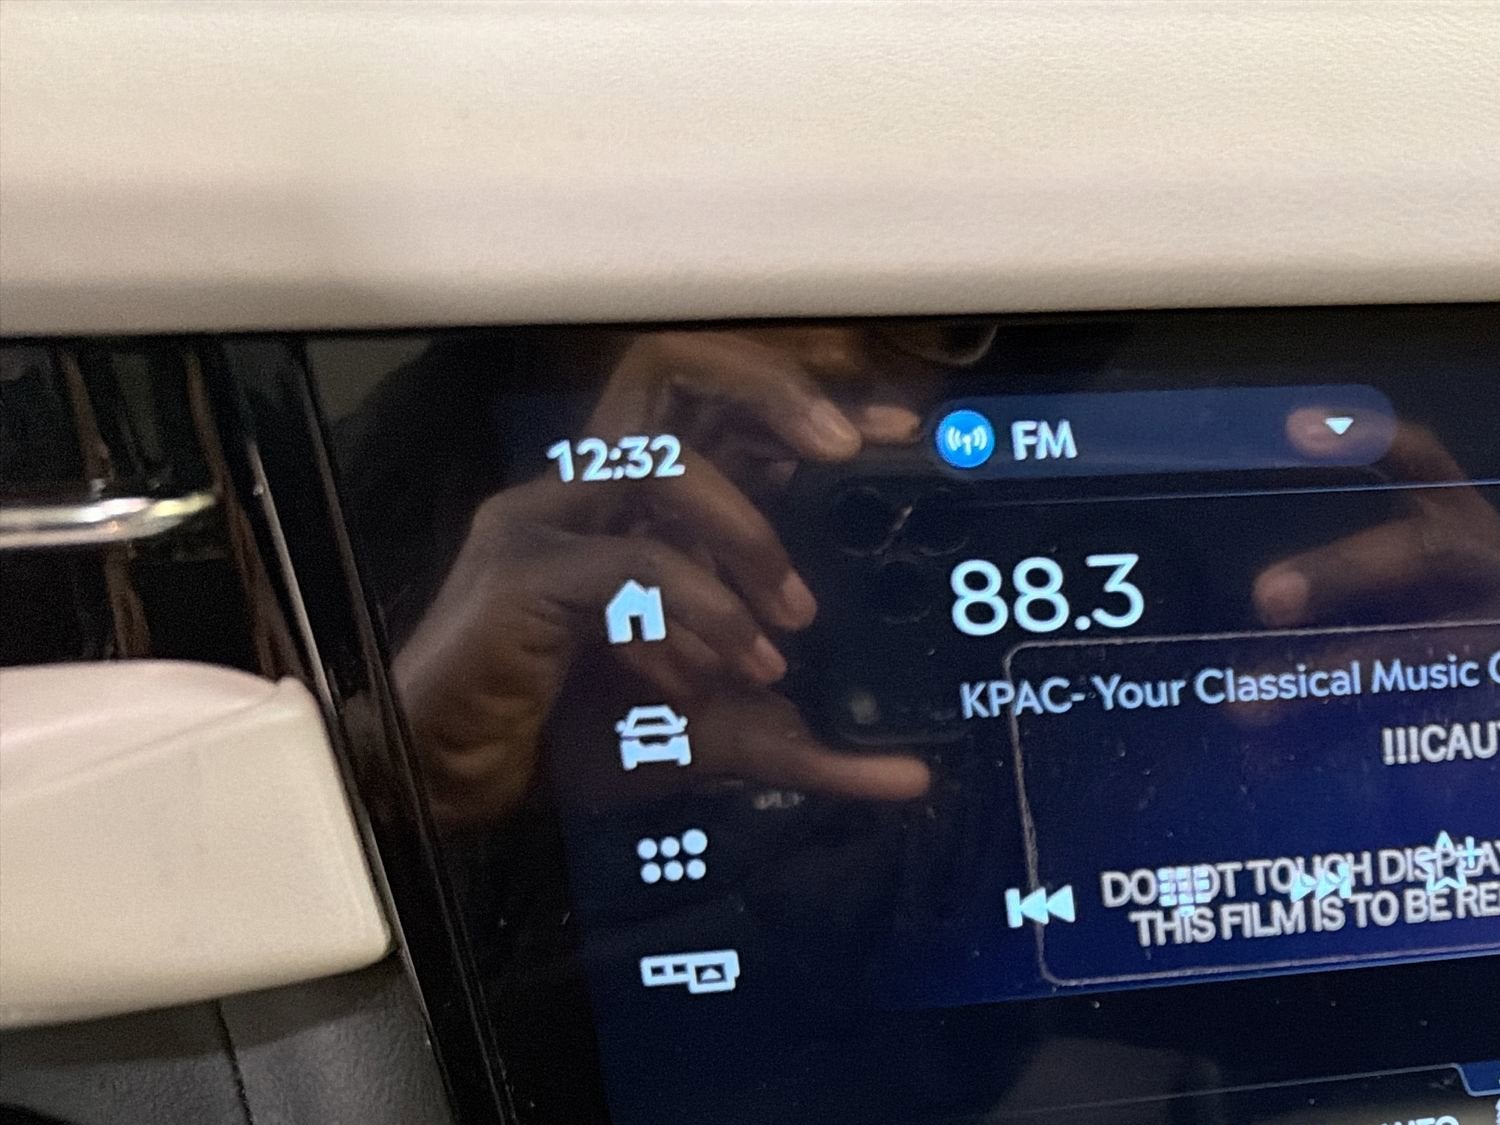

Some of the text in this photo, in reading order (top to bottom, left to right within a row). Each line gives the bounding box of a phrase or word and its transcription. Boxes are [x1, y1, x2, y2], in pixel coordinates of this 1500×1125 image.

[546, 434, 686, 484] 12:32
[1011, 420, 1078, 461] FM
[949, 552, 1145, 637] 88.3
[1091, 663, 1186, 711] Your
[1194, 659, 1362, 704] Classical
[1371, 653, 1481, 694] Music
[1101, 867, 1158, 908] DO
[1129, 905, 1217, 947] THIS
[1220, 898, 1308, 940] FILM
[1312, 894, 1346, 932] IS
[1349, 888, 1400, 929] TO
[1403, 885, 1453, 924] BE
